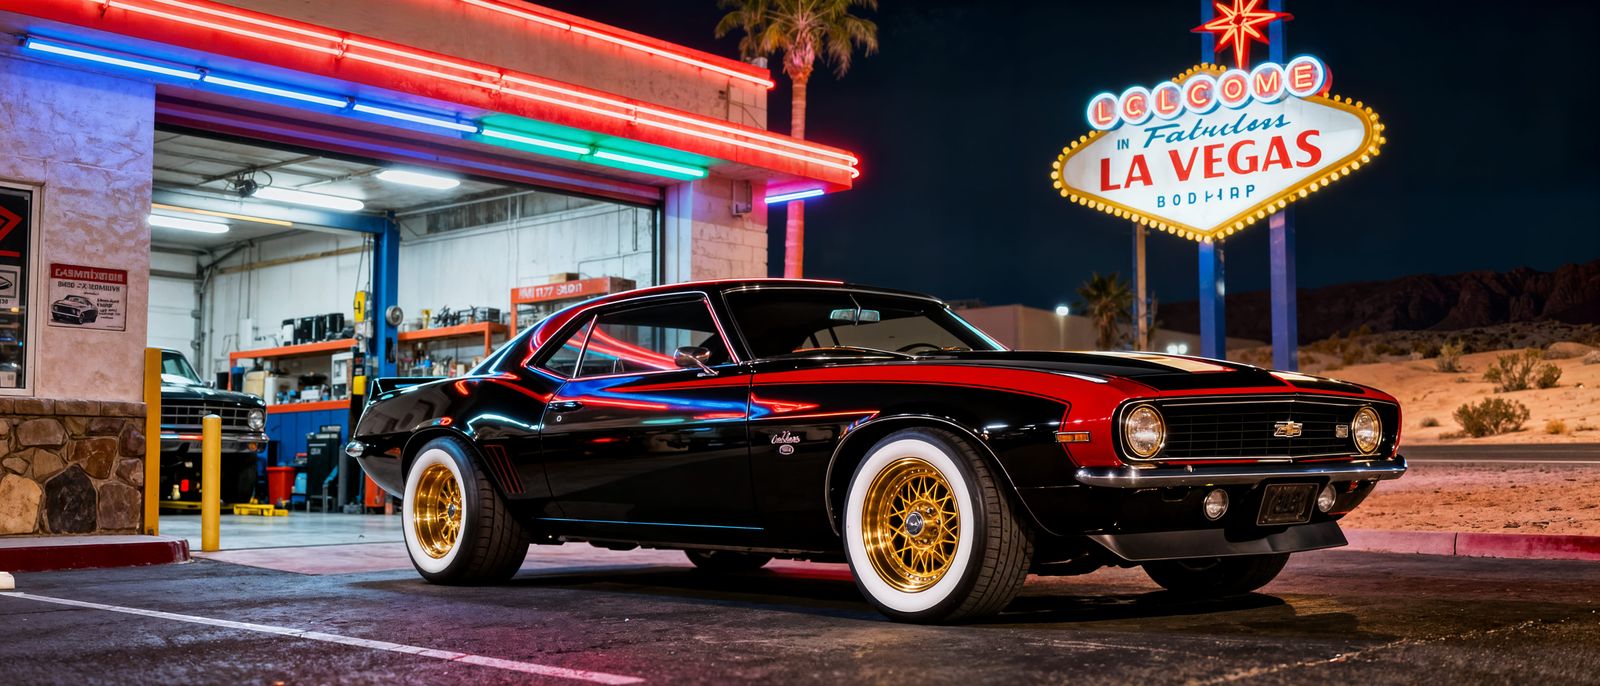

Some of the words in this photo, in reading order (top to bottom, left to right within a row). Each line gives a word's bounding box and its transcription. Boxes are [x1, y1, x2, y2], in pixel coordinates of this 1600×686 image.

[1099, 153, 1154, 192] LA
[1168, 129, 1323, 182] VEGAS
[1116, 138, 1130, 151] IN
